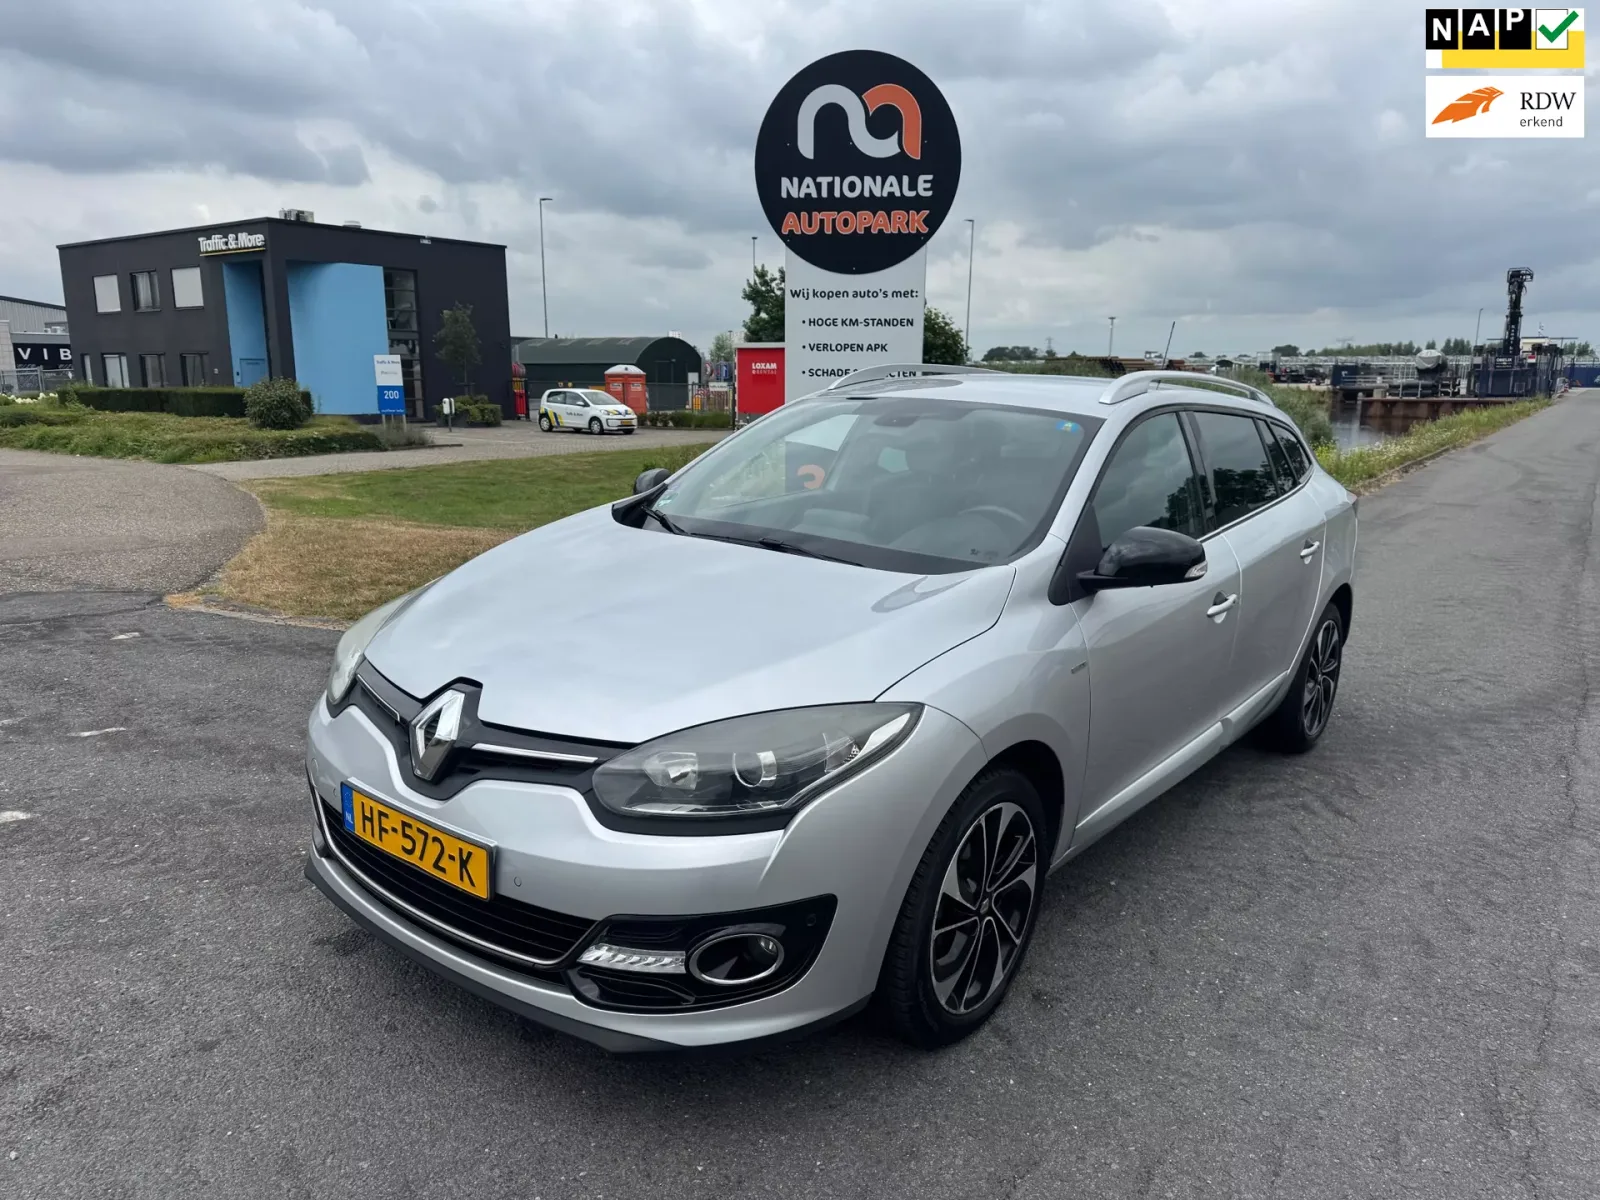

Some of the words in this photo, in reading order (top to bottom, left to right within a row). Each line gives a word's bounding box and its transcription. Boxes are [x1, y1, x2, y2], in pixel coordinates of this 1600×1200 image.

[780, 174, 934, 199] NATIONALE
[781, 210, 930, 235] AUTOPARK
[198, 234, 228, 252] Traffic
[228, 233, 237, 249] &
[238, 232, 265, 248] More
[790, 288, 810, 300] Wij
[812, 288, 849, 300] kopen
[852, 288, 889, 299] auto's
[891, 289, 919, 299] met:
[808, 318, 839, 327] HOGE
[841, 318, 914, 327] KM-STANDEN
[17, 347, 72, 360] VIB
[808, 343, 864, 352] VERLOPEN
[866, 343, 888, 352] APK
[383, 390, 400, 399] 200
[360, 801, 476, 888] HF-572-K
